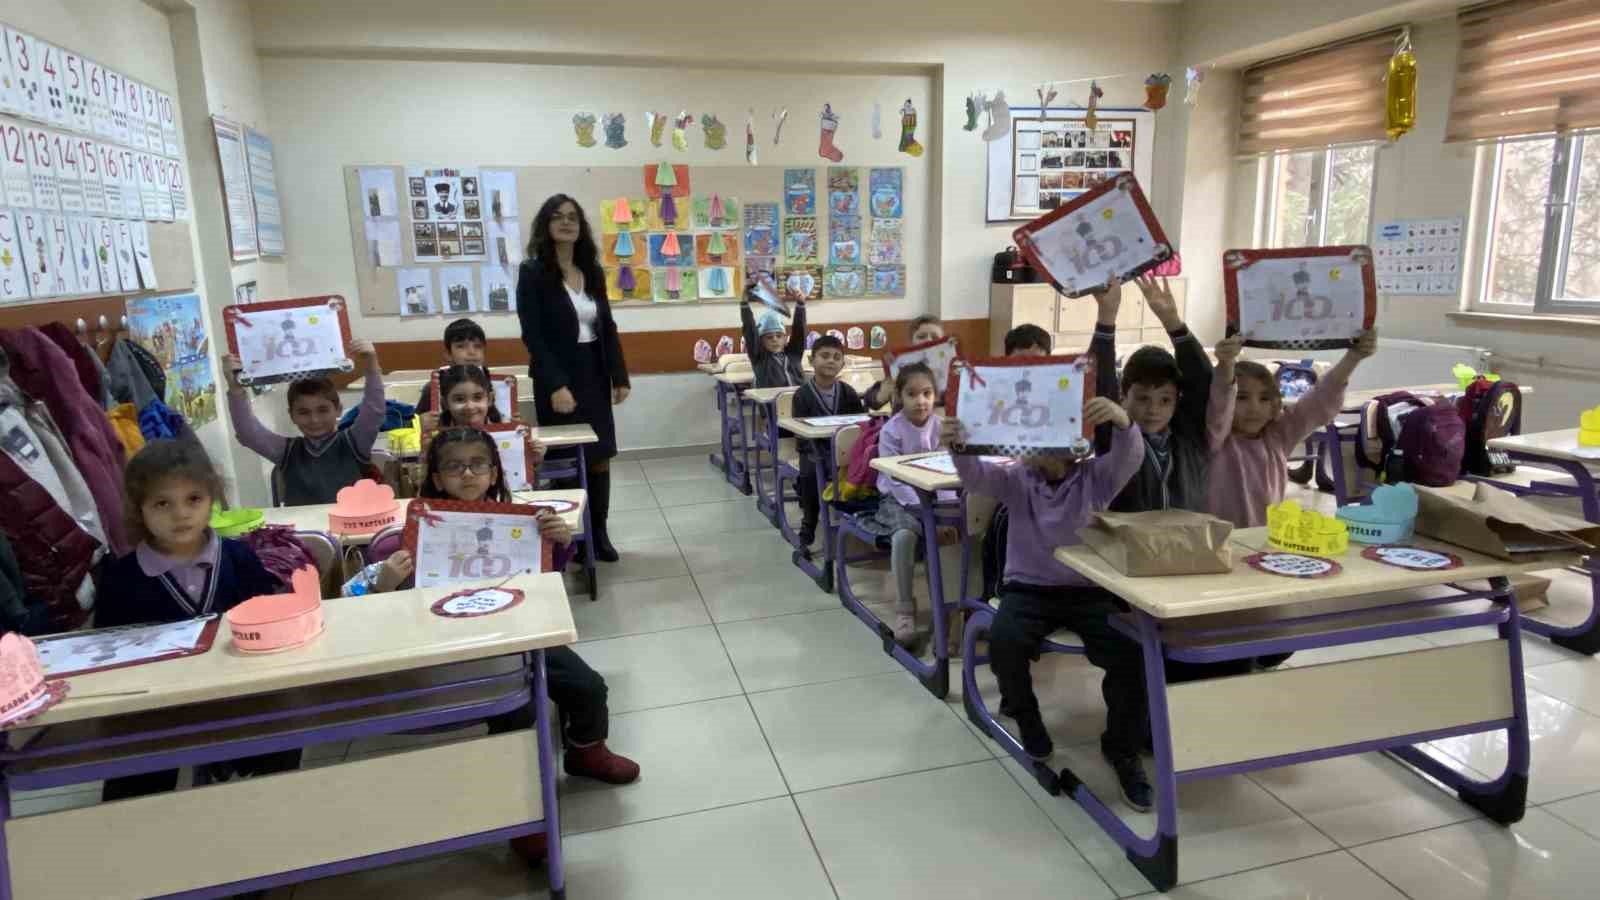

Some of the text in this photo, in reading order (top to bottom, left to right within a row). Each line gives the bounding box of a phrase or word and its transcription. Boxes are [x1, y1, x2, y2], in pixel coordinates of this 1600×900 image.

[16, 35, 29, 71] 3
[43, 48, 56, 81] 4
[67, 56, 79, 88] 5
[91, 67, 101, 96] 6
[110, 74, 119, 104] 7
[129, 84, 138, 112] 8
[160, 96, 172, 122] 10
[0, 125, 24, 163] 12
[28, 131, 50, 167] 13
[54, 136, 78, 171] 14
[79, 141, 96, 172] 15
[101, 147, 117, 177] 16
[120, 152, 133, 179] 17
[138, 155, 153, 183] 18
[25, 215, 34, 242] P
[53, 218, 66, 244] H
[78, 221, 88, 245] V
